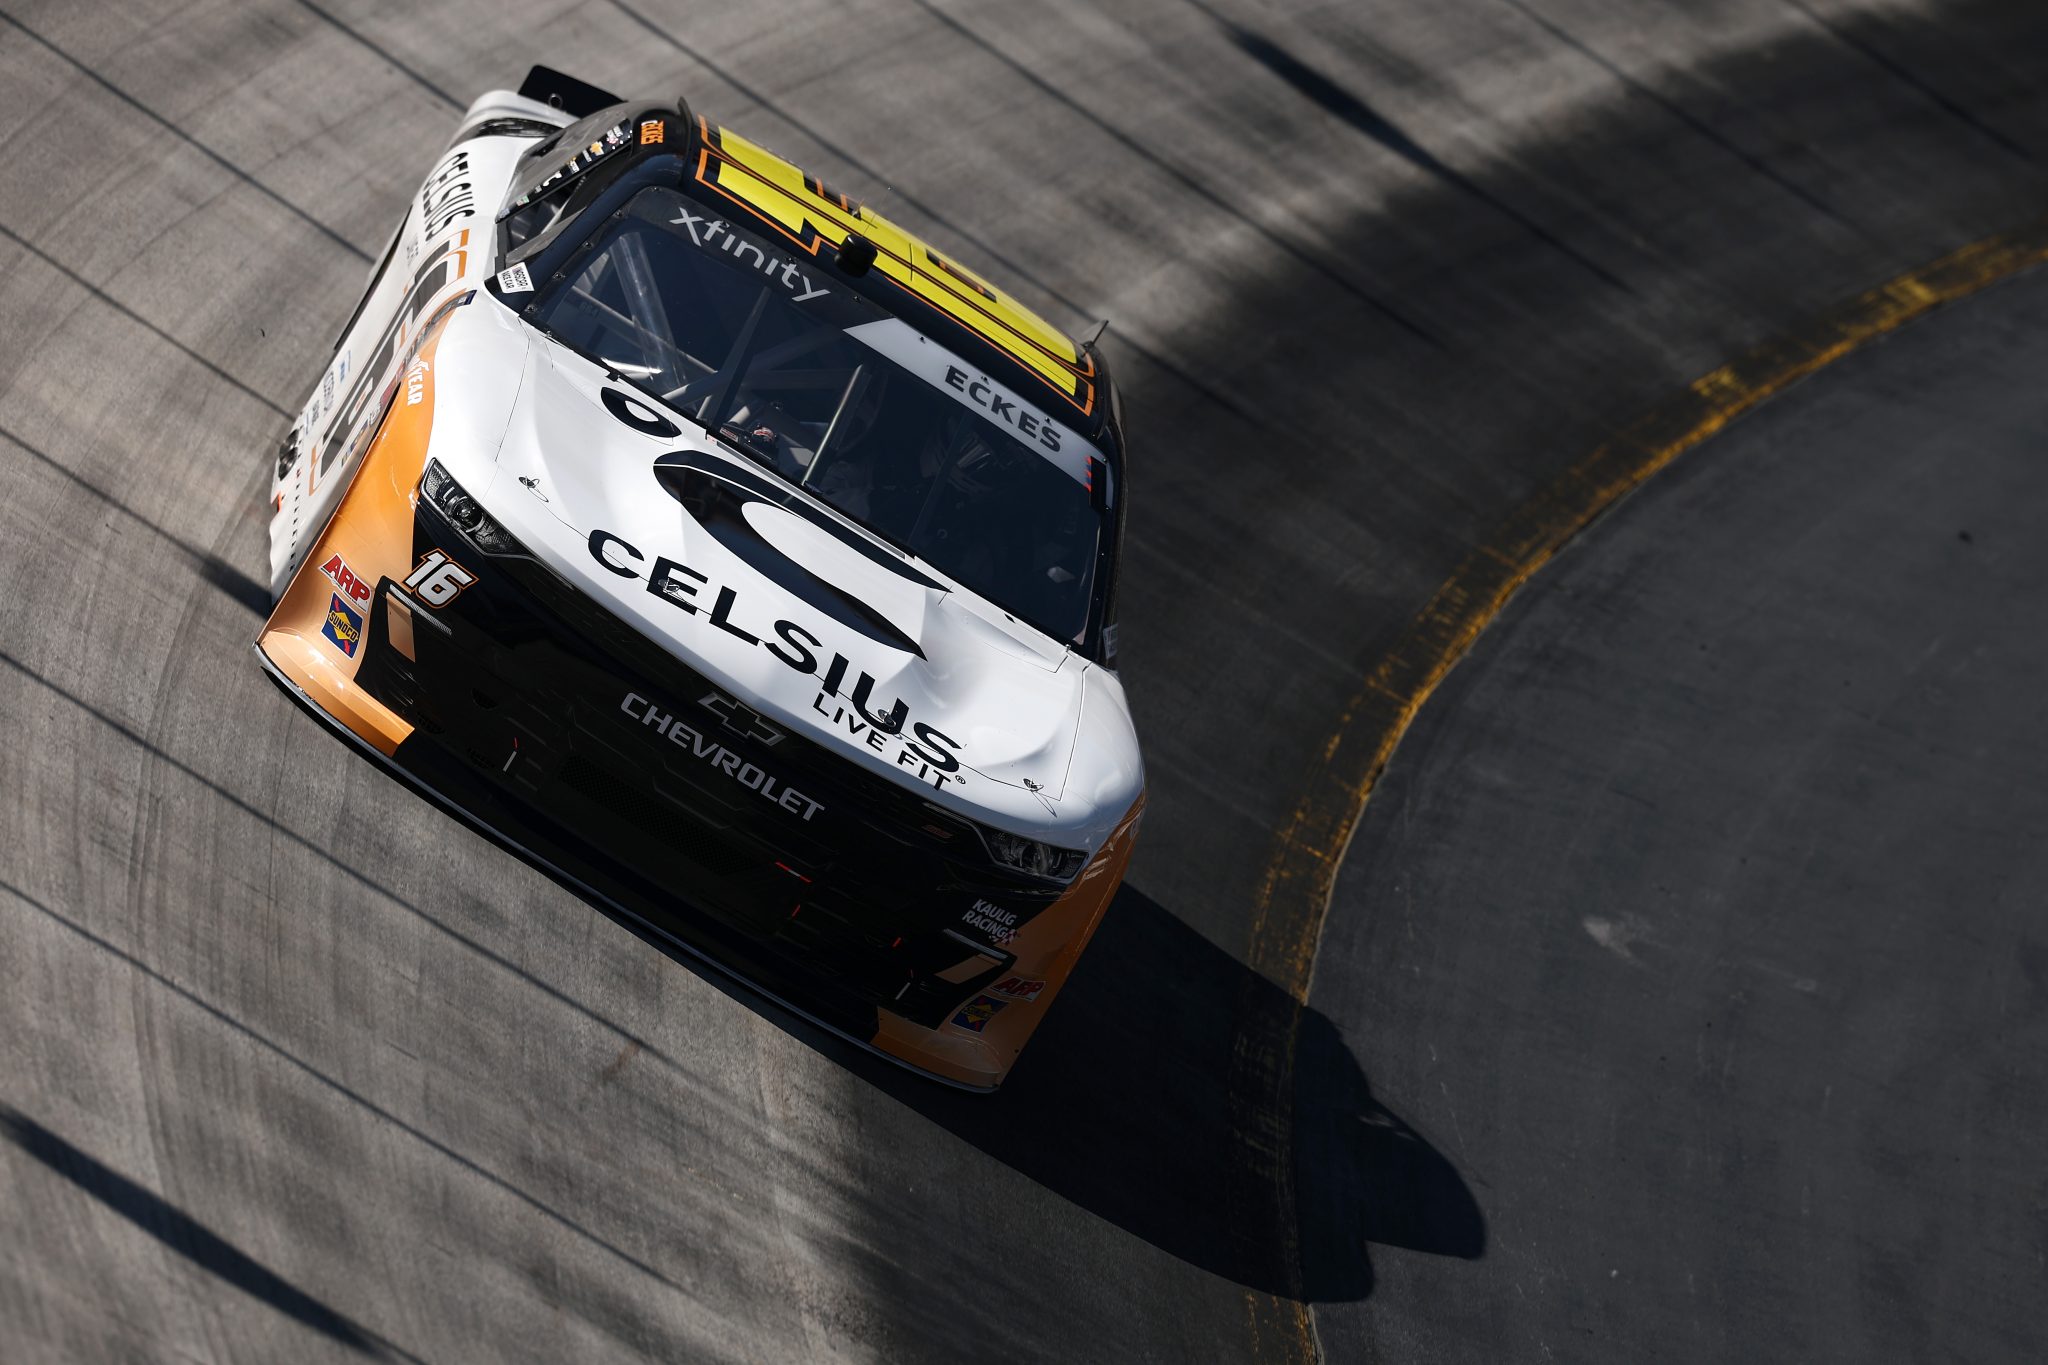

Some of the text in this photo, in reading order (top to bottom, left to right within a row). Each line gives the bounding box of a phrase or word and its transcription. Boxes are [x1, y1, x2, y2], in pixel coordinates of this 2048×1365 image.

[944, 365, 1062, 452] ECKES
[322, 555, 370, 601] ARP
[403, 550, 475, 606] 16
[329, 612, 358, 641] SUNOCO
[588, 529, 963, 772] CELSIUS
[813, 692, 888, 752] LIVE
[620, 692, 826, 822] CHEVROLET
[962, 910, 1009, 938] RACING
[972, 899, 1017, 926] KAULIG
